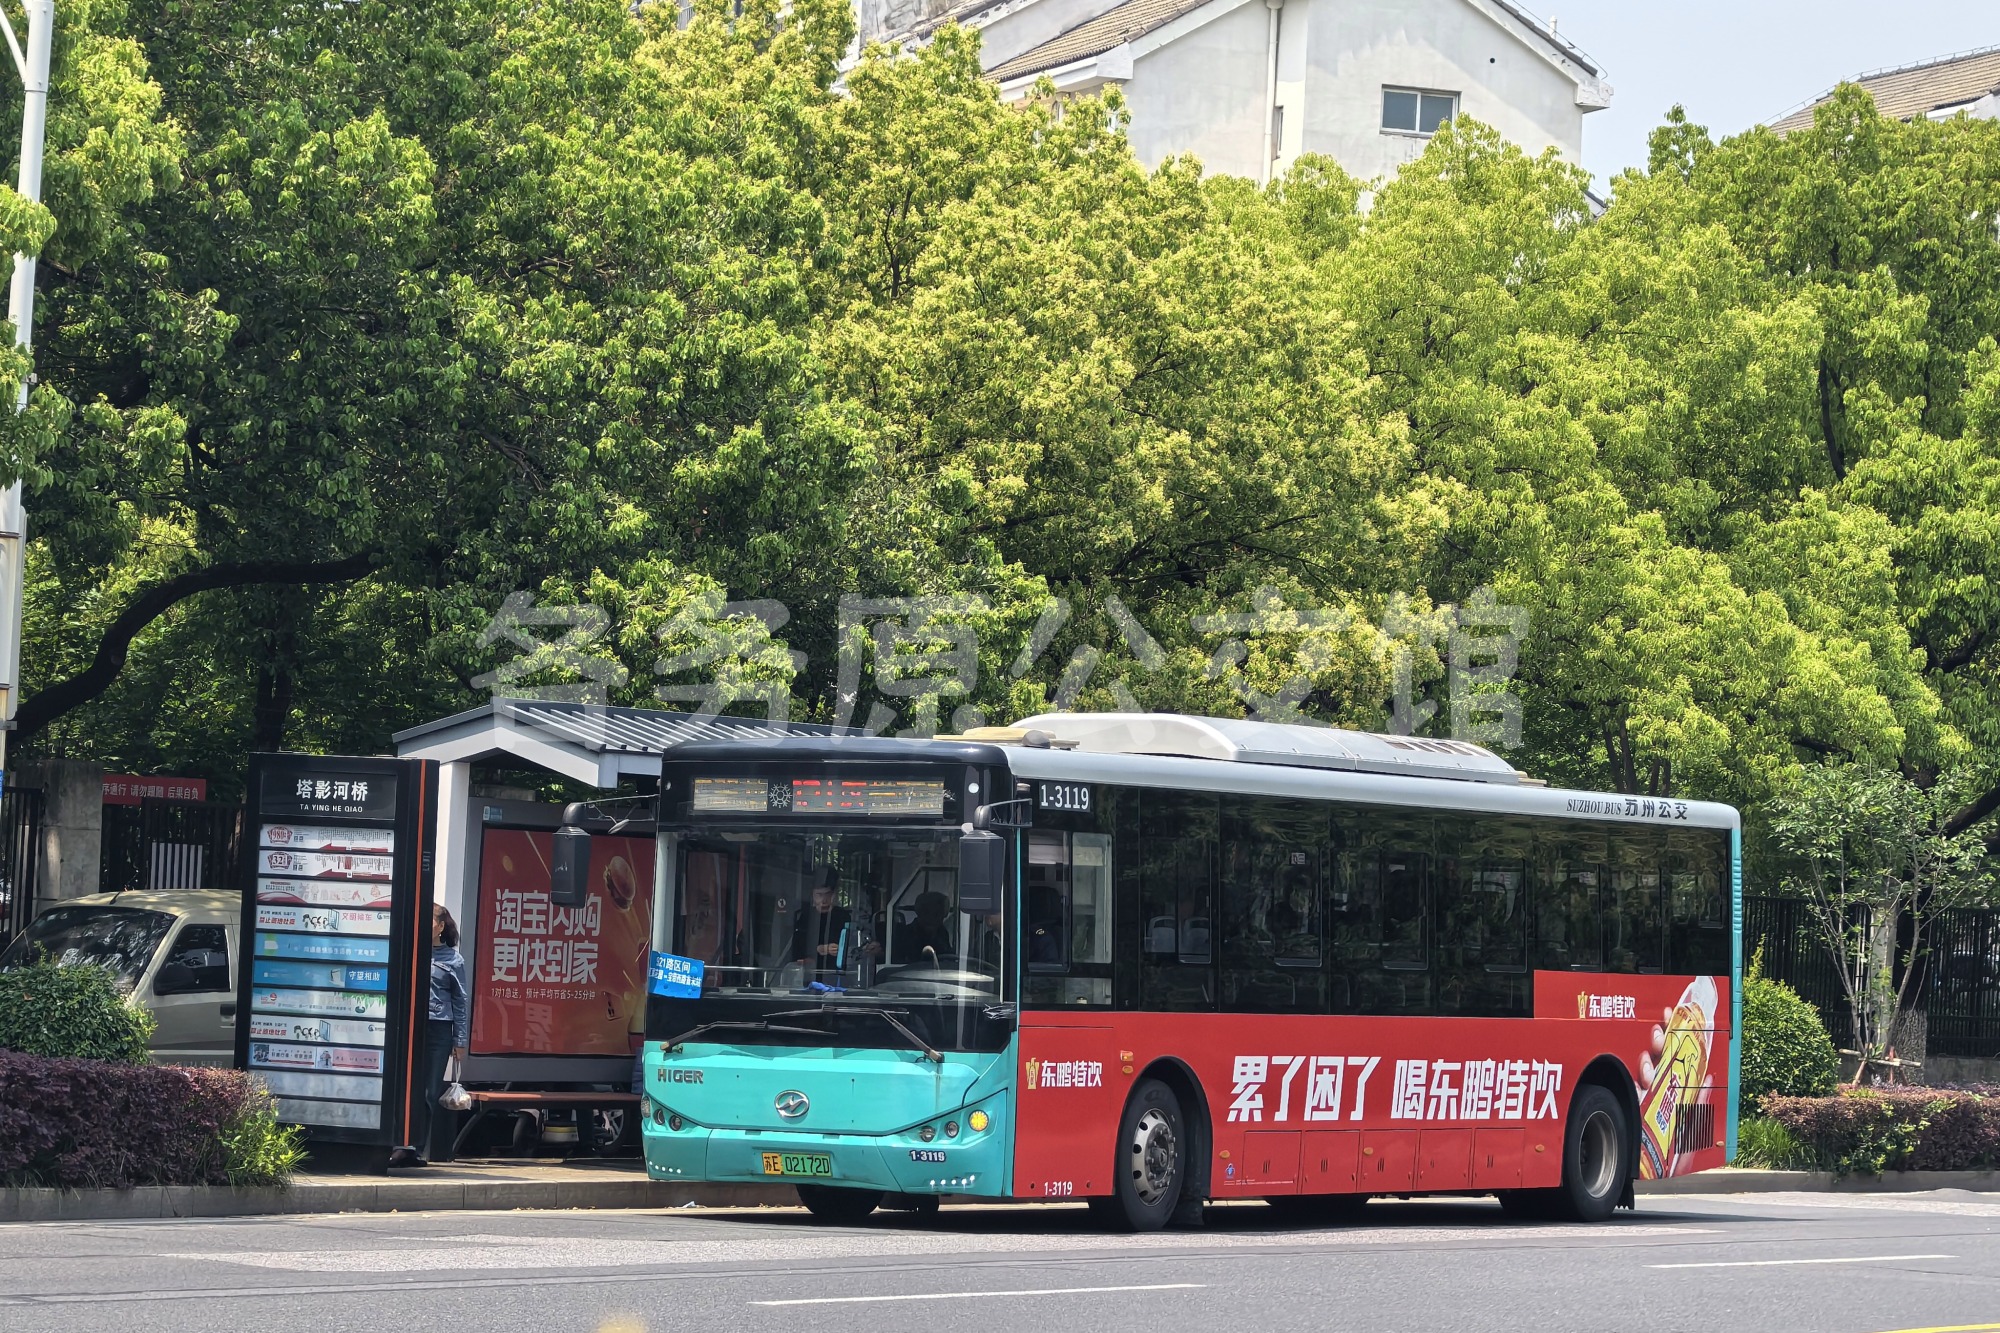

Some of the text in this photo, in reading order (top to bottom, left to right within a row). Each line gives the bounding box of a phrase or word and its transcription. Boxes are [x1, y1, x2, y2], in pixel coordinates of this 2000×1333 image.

[167, 787, 199, 800] 后果自负
[296, 778, 369, 802] 塔影河桥
[1039, 784, 1090, 810] 1-3119
[300, 803, 309, 811] TA
[312, 804, 330, 812] YING
[1566, 798, 1688, 820] SUZHOU BUS 苏州公交
[493, 888, 602, 937] 淘宝闪购
[491, 937, 599, 985] 更快到家
[1588, 993, 1636, 1019] 东鹏特饮
[657, 1068, 704, 1084] HIGER
[1041, 1059, 1103, 1088] 东鹏特饮
[1226, 1055, 1563, 1122] 累了困了 喝东鹏特饮
[763, 1155, 830, 1174] 苏E 02172D
[1044, 1181, 1073, 1196] 1-3119
